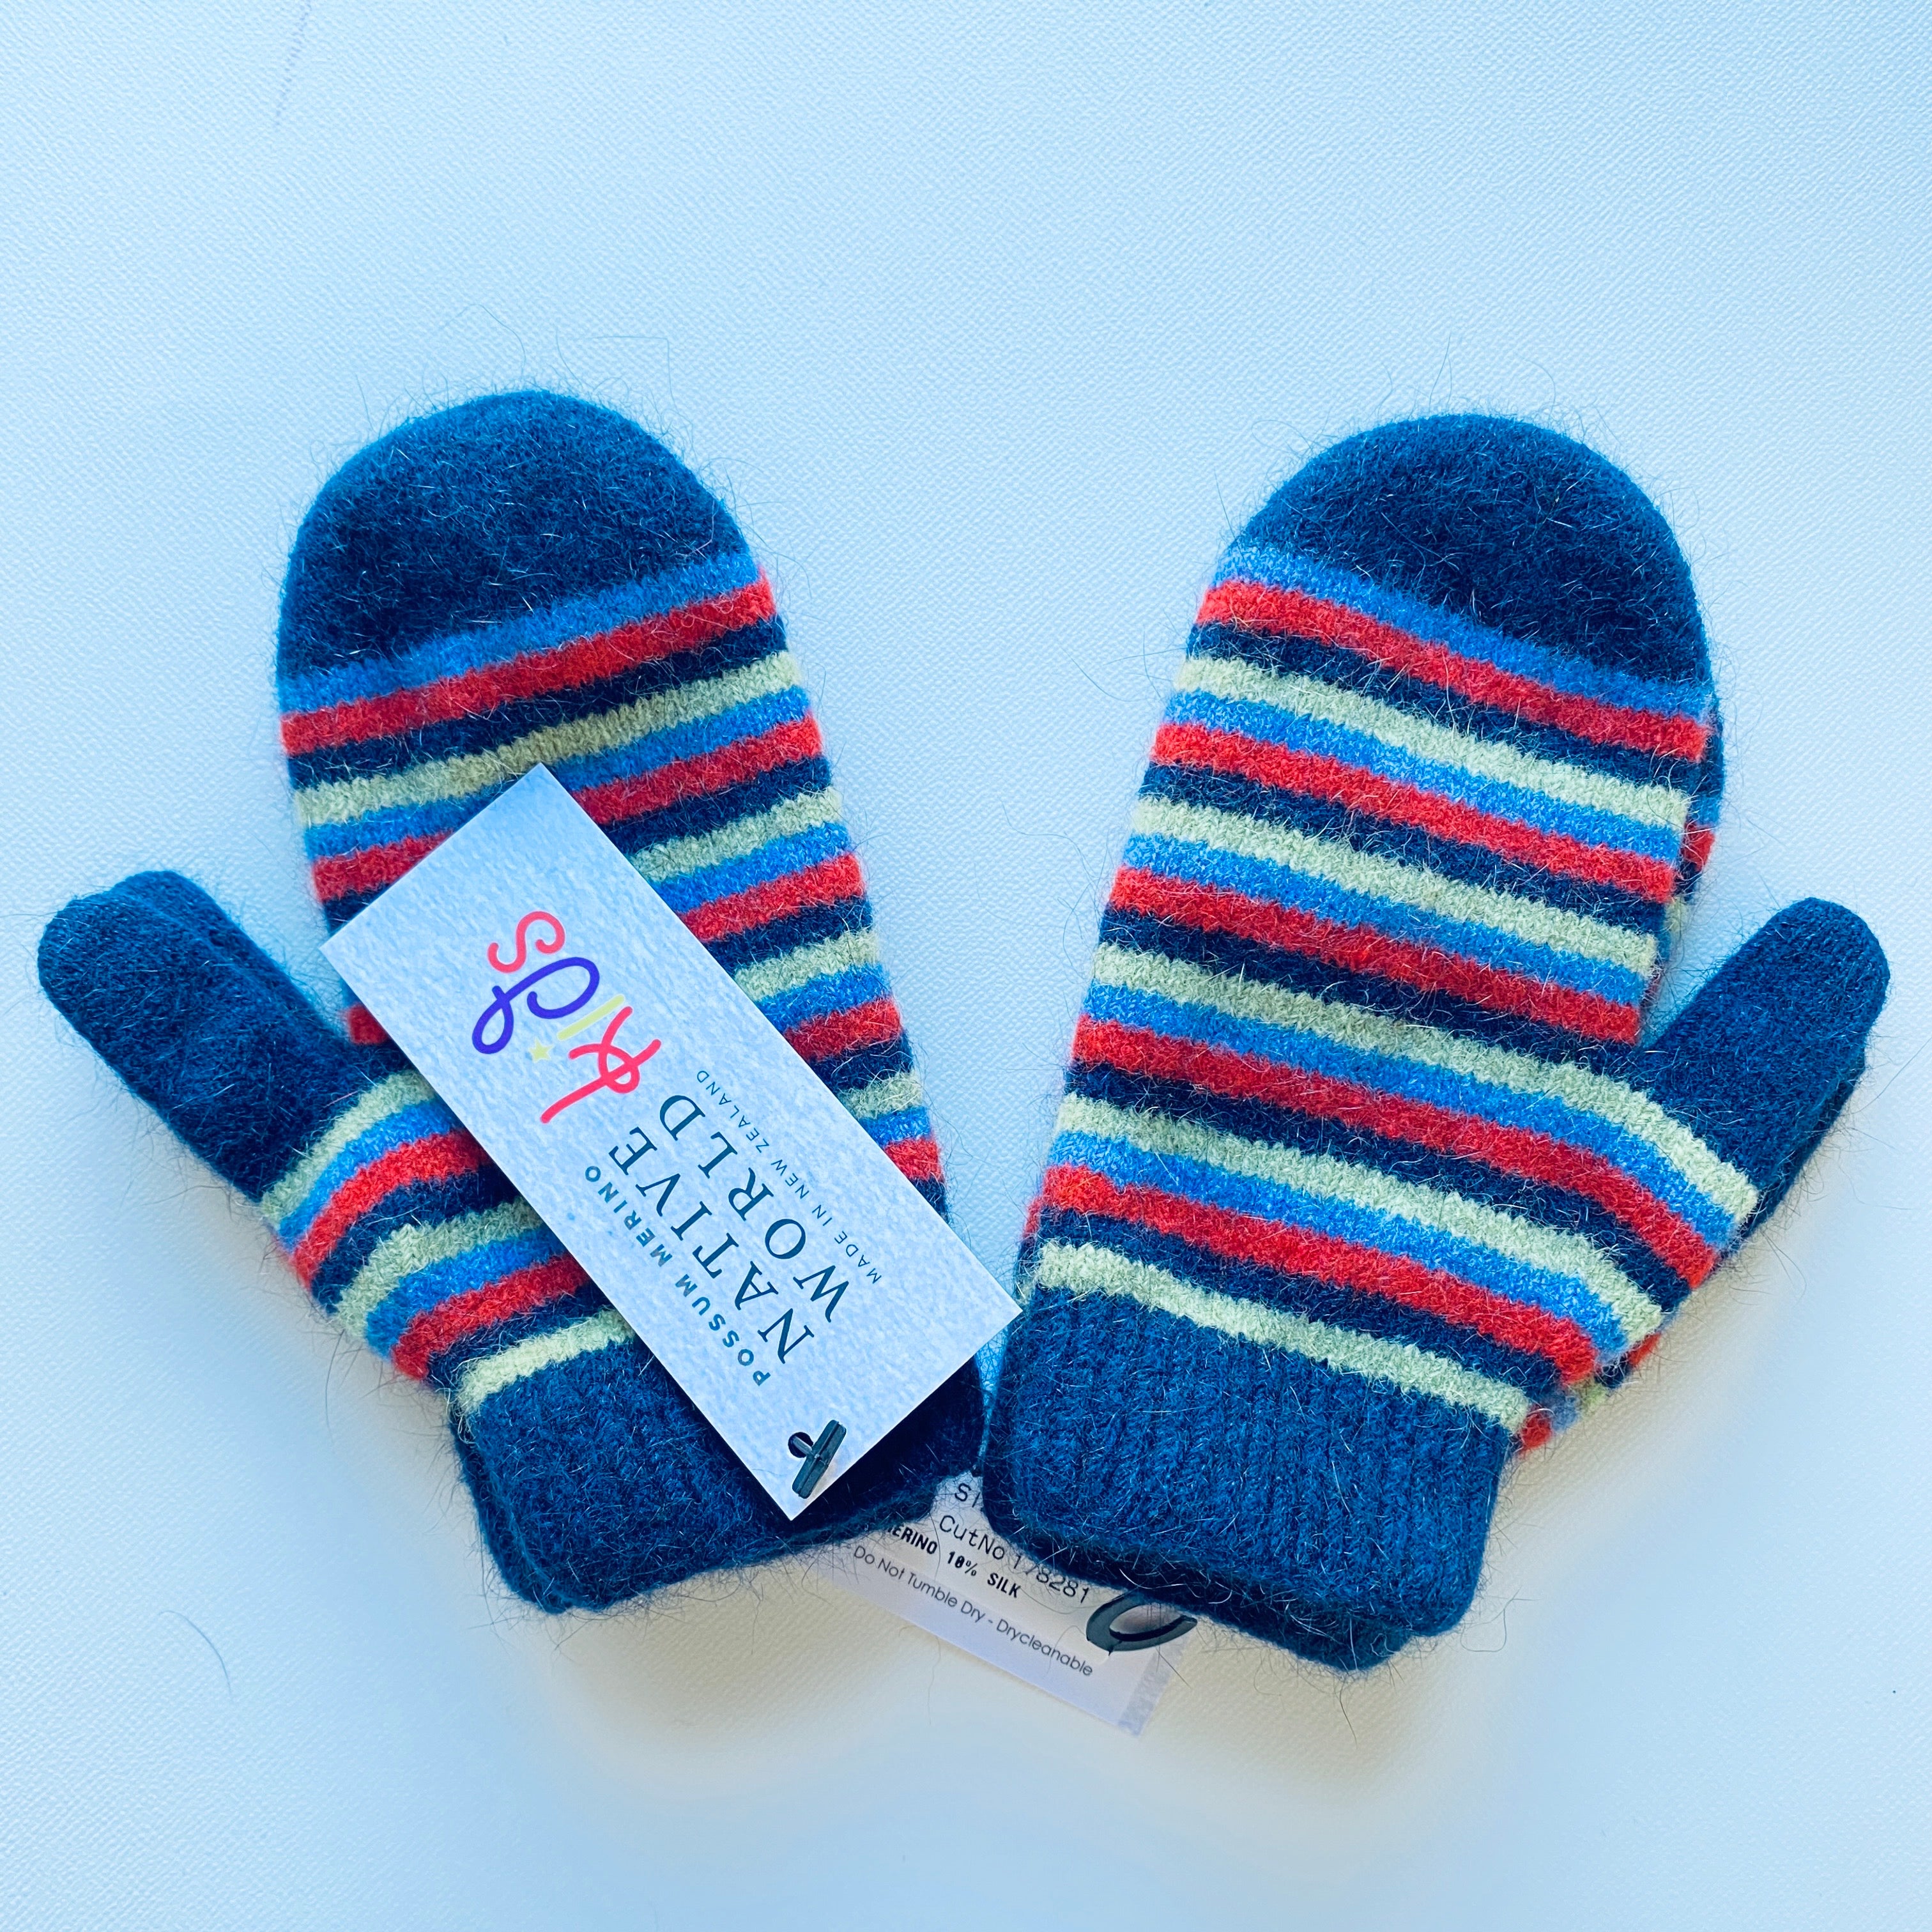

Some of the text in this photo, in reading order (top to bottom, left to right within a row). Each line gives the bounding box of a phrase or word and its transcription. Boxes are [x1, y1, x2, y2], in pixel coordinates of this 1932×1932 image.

[472, 910, 661, 1124] kids
[585, 1165, 770, 1386] POSSUM MERINO
[608, 1126, 815, 1364] NATIVE
[660, 1095, 849, 1322] WORLD
[696, 1070, 882, 1284] MADE IN NEW ZEALAND
[854, 1546, 875, 1564] Do
[878, 1558, 905, 1579] Not
[908, 1572, 957, 1607] Tumble
[961, 1601, 986, 1623] Dry
[996, 1619, 1093, 1676] Drycleanable
[887, 1524, 1021, 1598] ERINO 10% SILK
[939, 1515, 1005, 1560] CutNo
